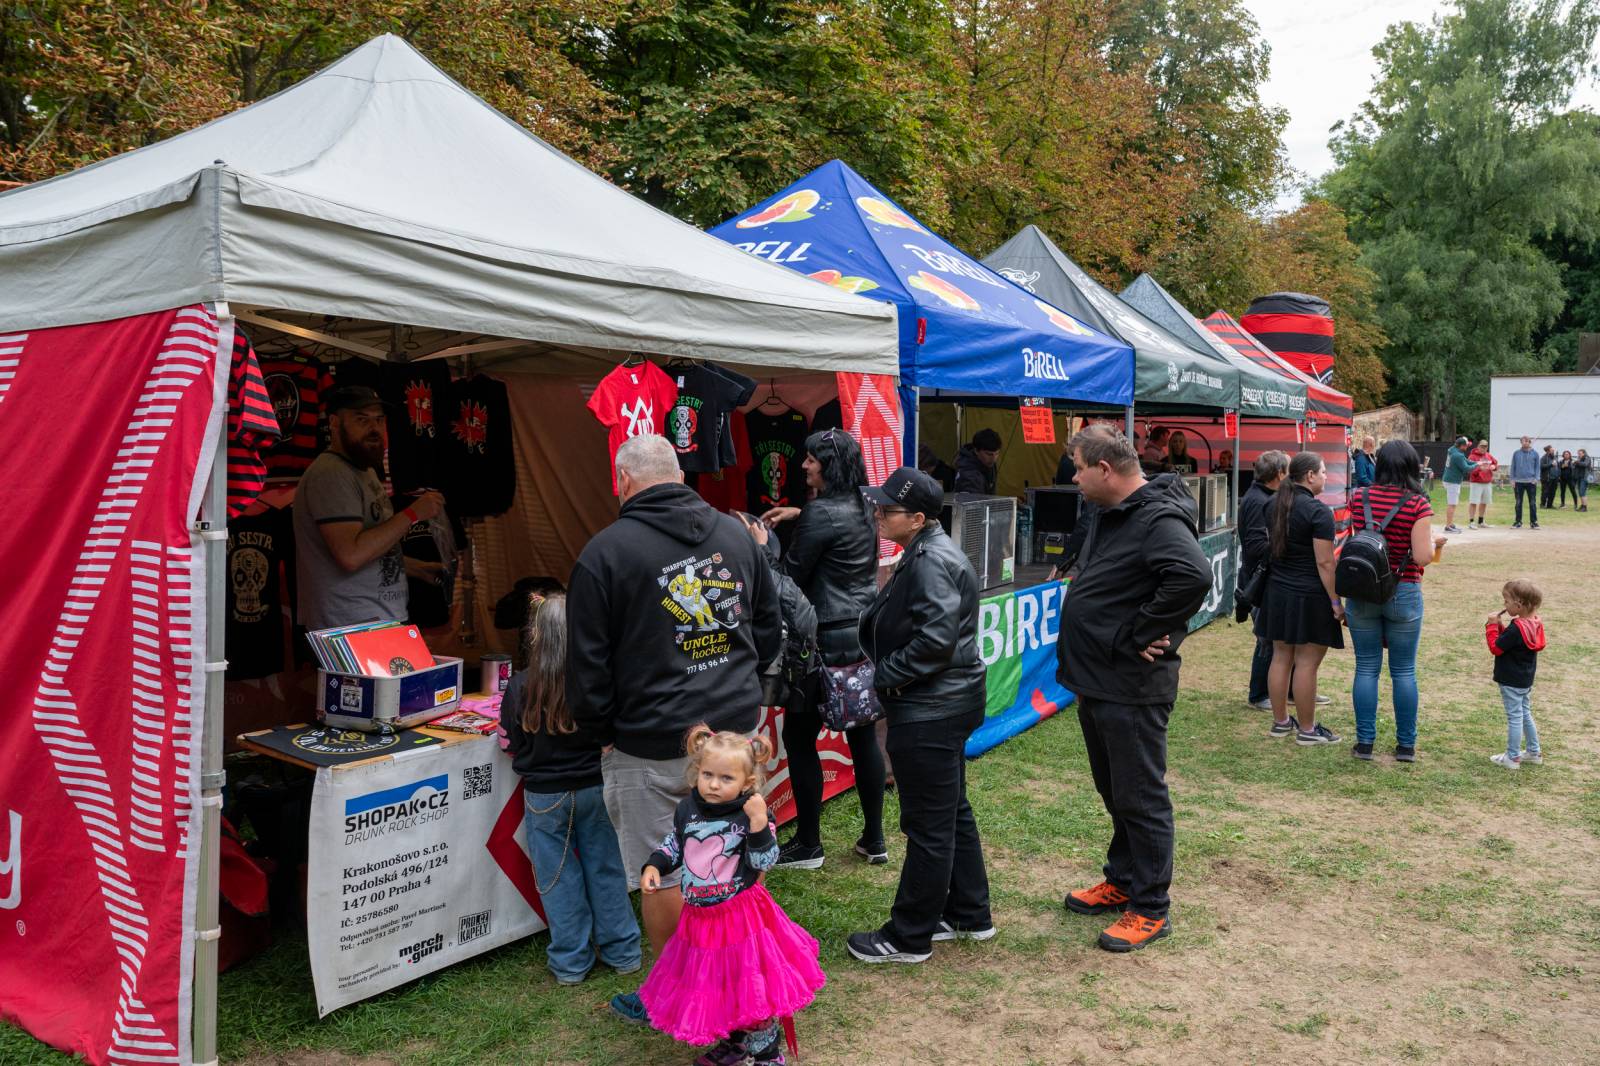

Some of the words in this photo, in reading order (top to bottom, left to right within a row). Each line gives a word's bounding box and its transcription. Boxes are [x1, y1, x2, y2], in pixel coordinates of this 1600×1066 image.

[702, 579, 735, 590] HANDMADE
[661, 596, 692, 624] HONEST
[683, 633, 728, 651] UNCLE
[692, 644, 731, 660] hockey
[687, 664, 697, 675] 777
[698, 662, 707, 671] 85
[708, 659, 718, 667] 96
[345, 825, 386, 846] DRUNK
[388, 816, 418, 833] ROCK
[419, 807, 449, 825] SHOP
[343, 849, 420, 879] Krakonošovo
[343, 870, 398, 895] Podolská
[401, 854, 449, 878] 496/124
[343, 896, 367, 911] 147
[370, 890, 386, 903] 00
[388, 880, 421, 898] Praha
[424, 874, 432, 885] 4
[340, 917, 354, 929] IČ:
[355, 903, 399, 925] 25786580
[399, 932, 444, 957] merch
[460, 923, 488, 943] KAPELY
